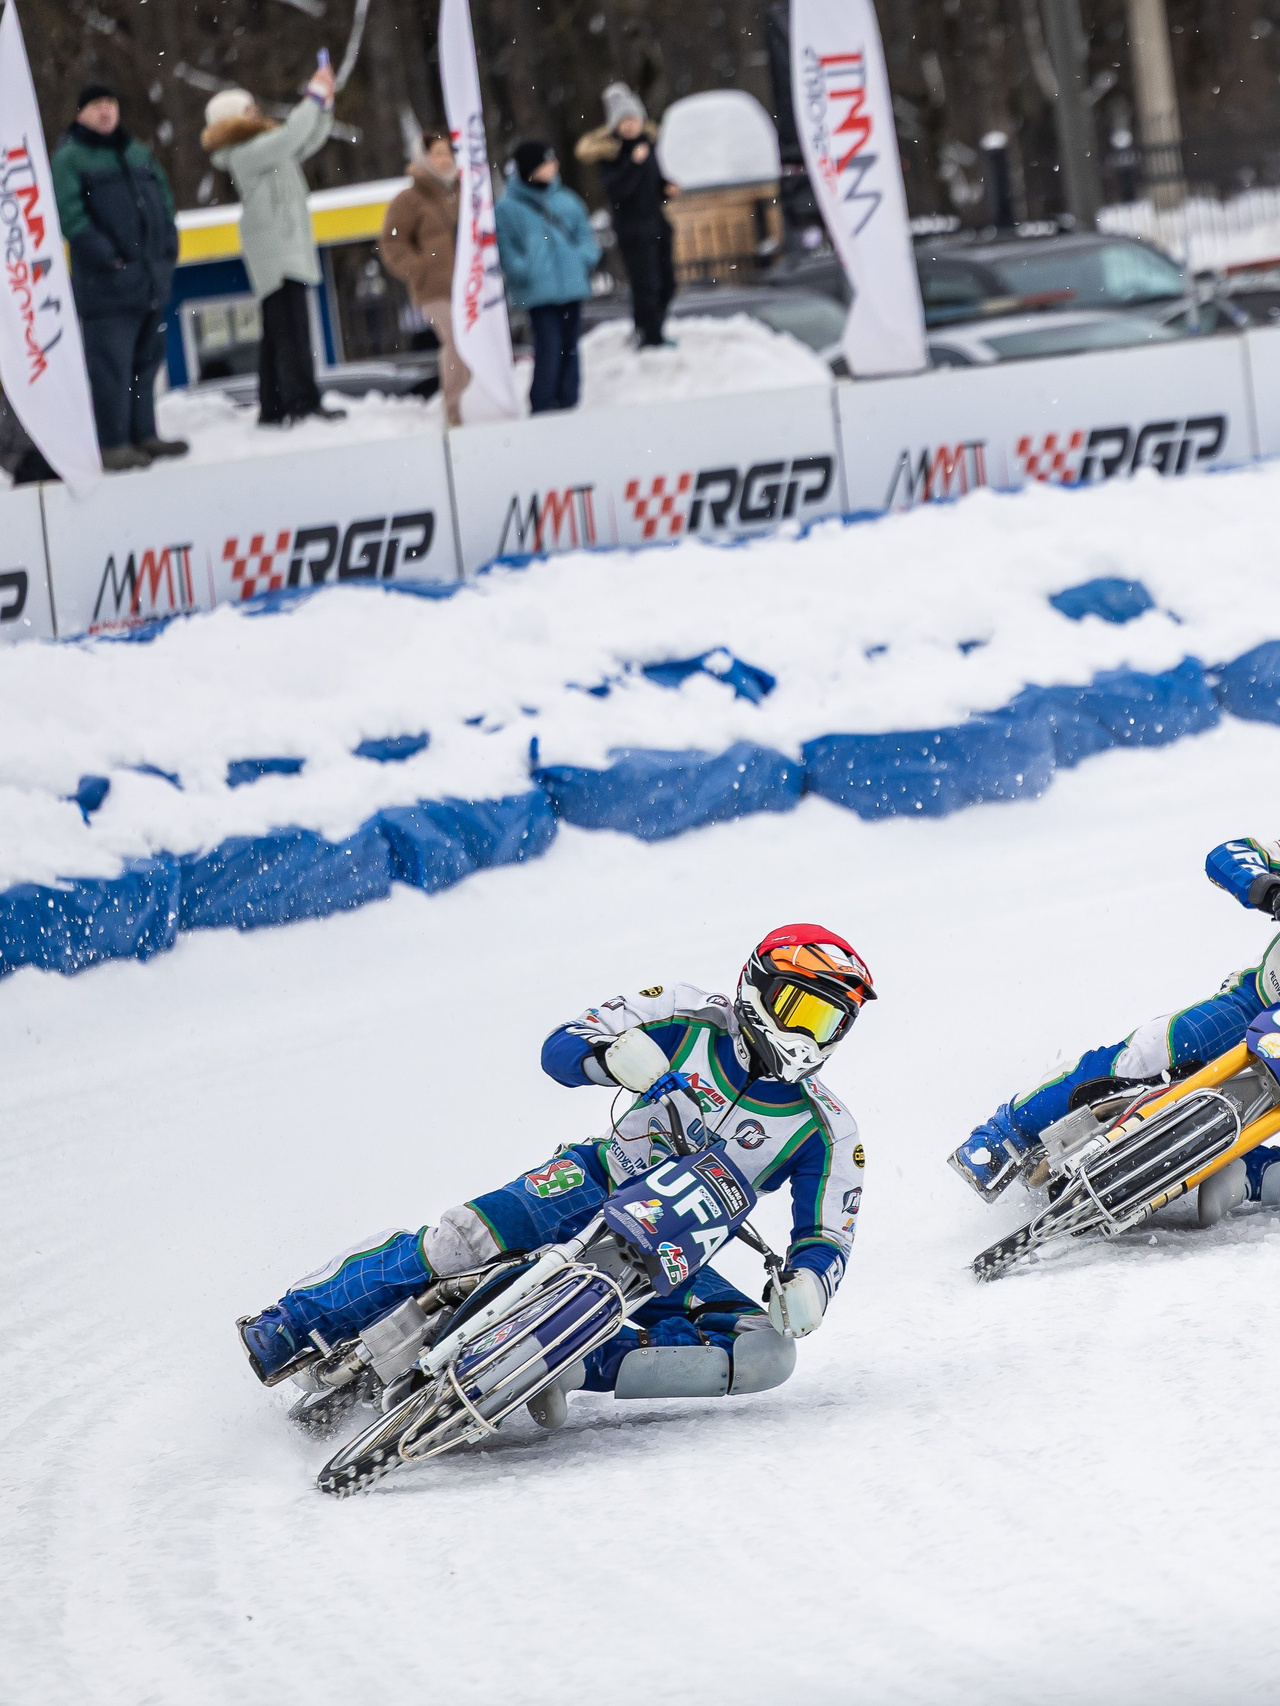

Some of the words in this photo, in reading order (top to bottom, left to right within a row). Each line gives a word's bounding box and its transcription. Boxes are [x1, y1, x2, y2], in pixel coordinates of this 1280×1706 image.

[497, 484, 596, 557] MMT
[687, 456, 833, 534] RGP
[884, 439, 986, 510] MMT
[1077, 414, 1229, 481] RGP
[94, 544, 194, 621] MMT
[287, 512, 435, 588] RGP
[646, 1161, 729, 1267] UFA
